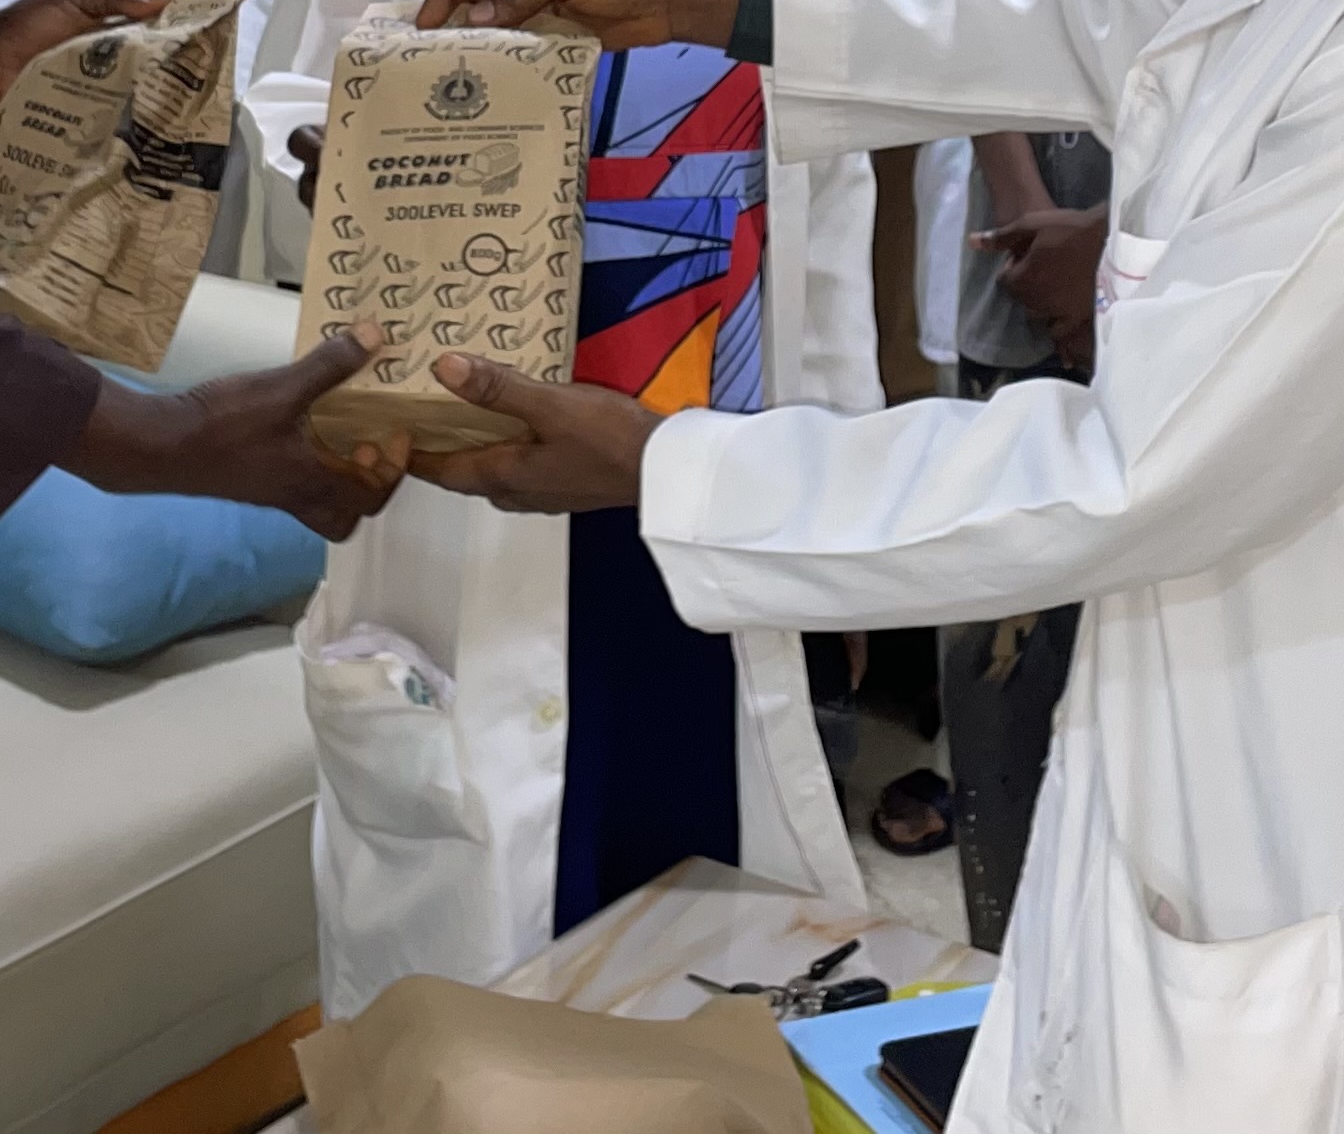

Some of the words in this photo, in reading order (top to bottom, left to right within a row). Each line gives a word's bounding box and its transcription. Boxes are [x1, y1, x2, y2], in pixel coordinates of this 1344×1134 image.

[367, 153, 472, 172] COCONUT
[373, 171, 452, 190] BREAD
[385, 203, 466, 222] 300LEVEL
[473, 202, 522, 218] SWEP
